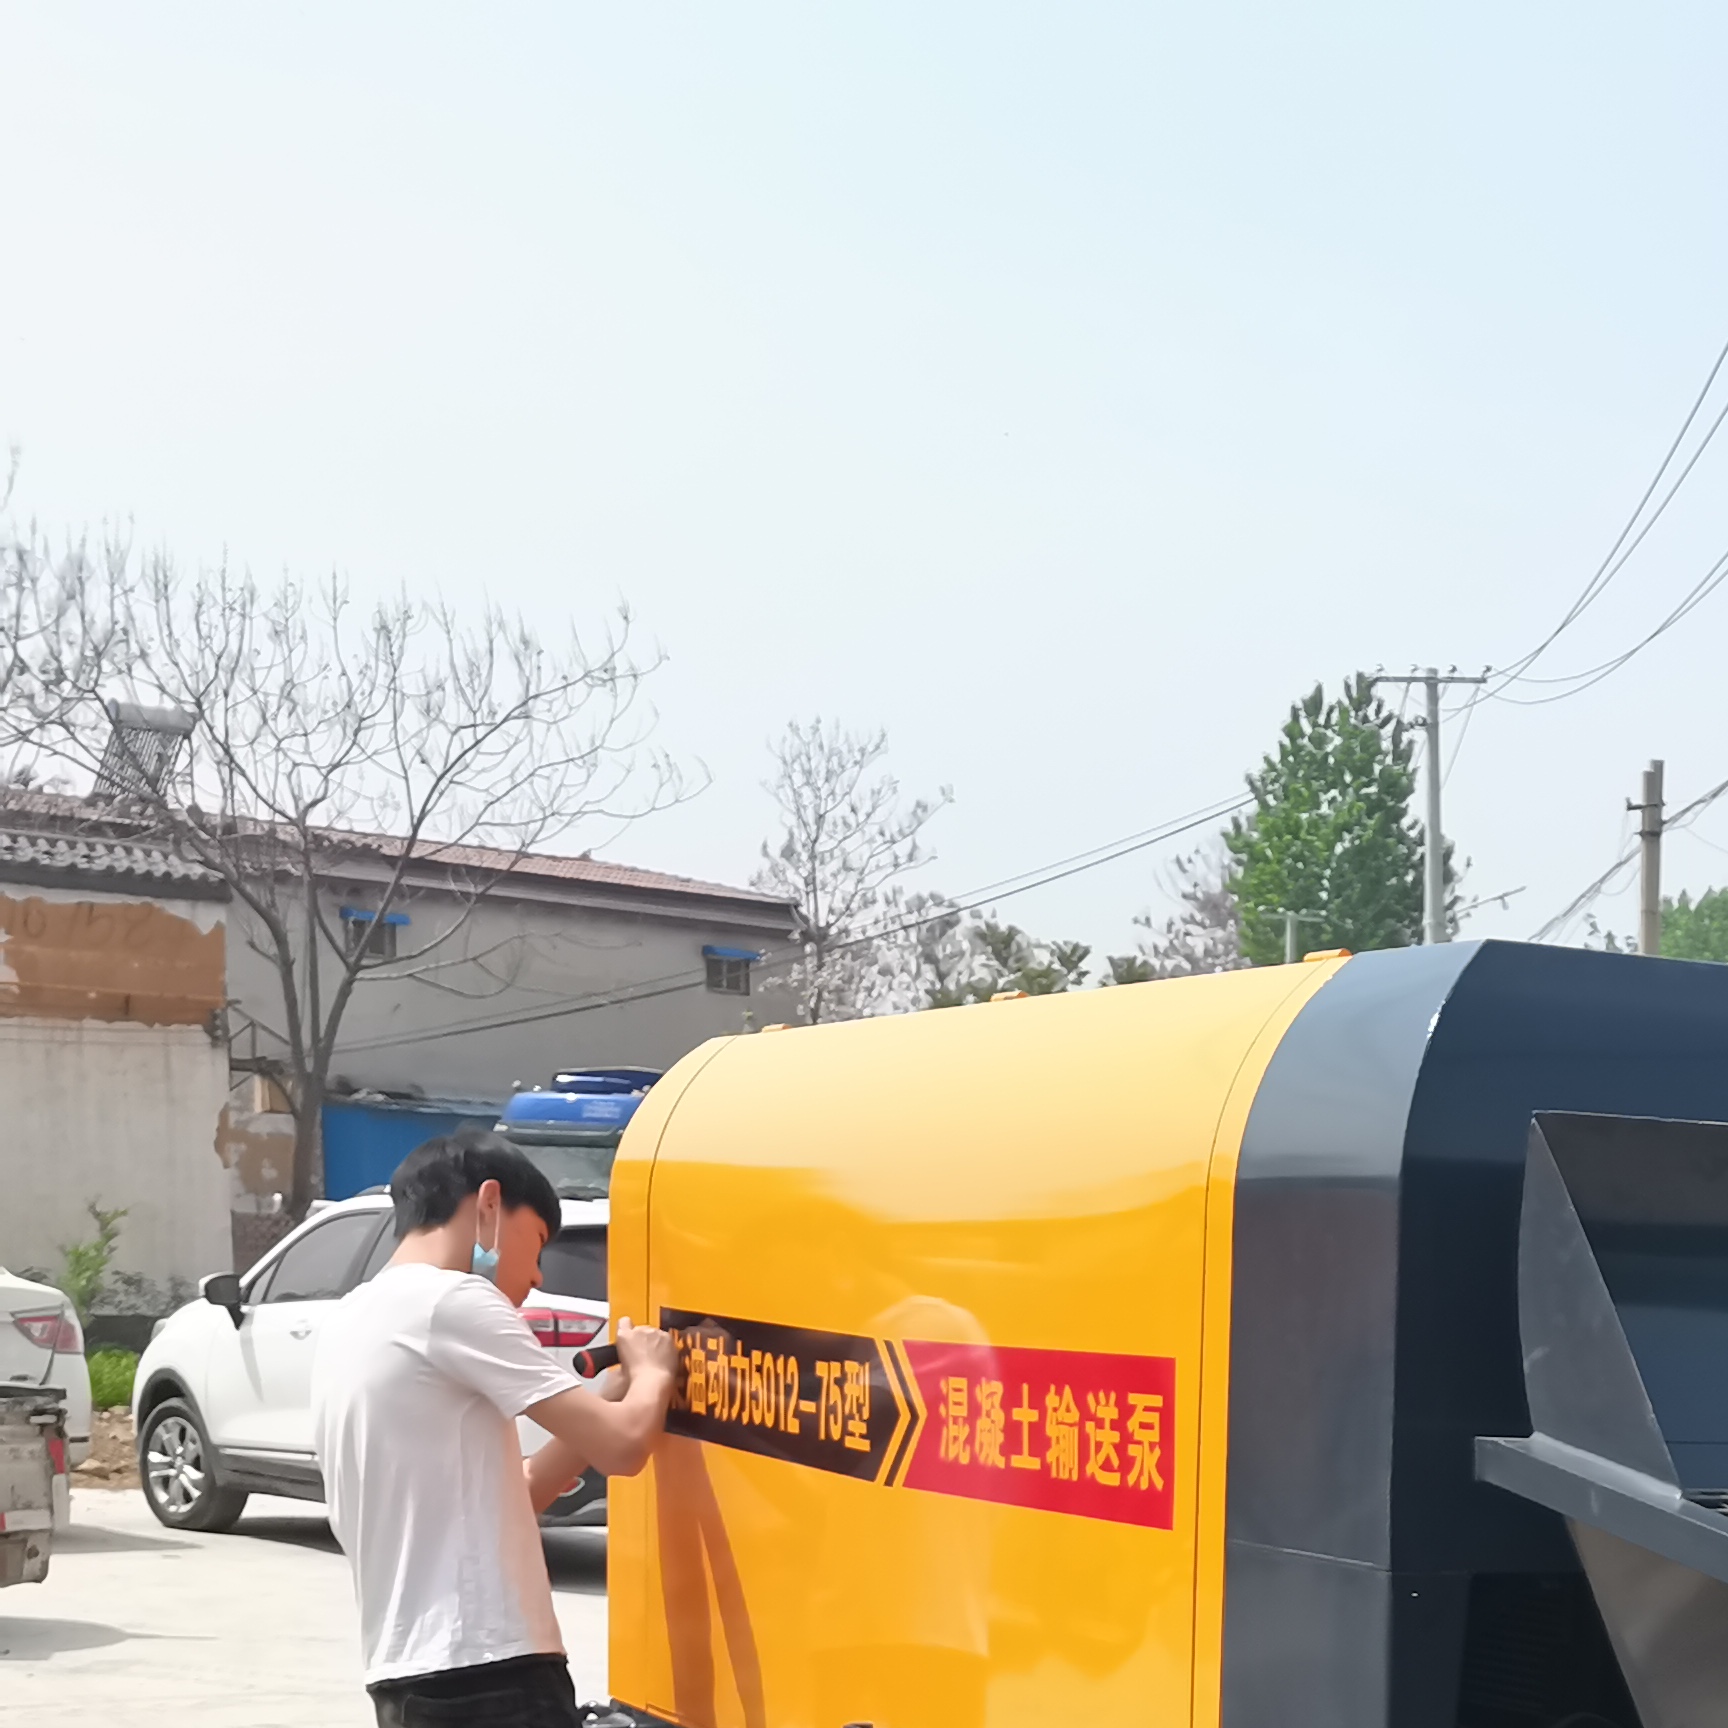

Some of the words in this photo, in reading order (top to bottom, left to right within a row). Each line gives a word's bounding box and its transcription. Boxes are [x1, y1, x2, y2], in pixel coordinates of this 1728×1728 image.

[939, 1376, 1164, 1491] 混凝土输送泵
